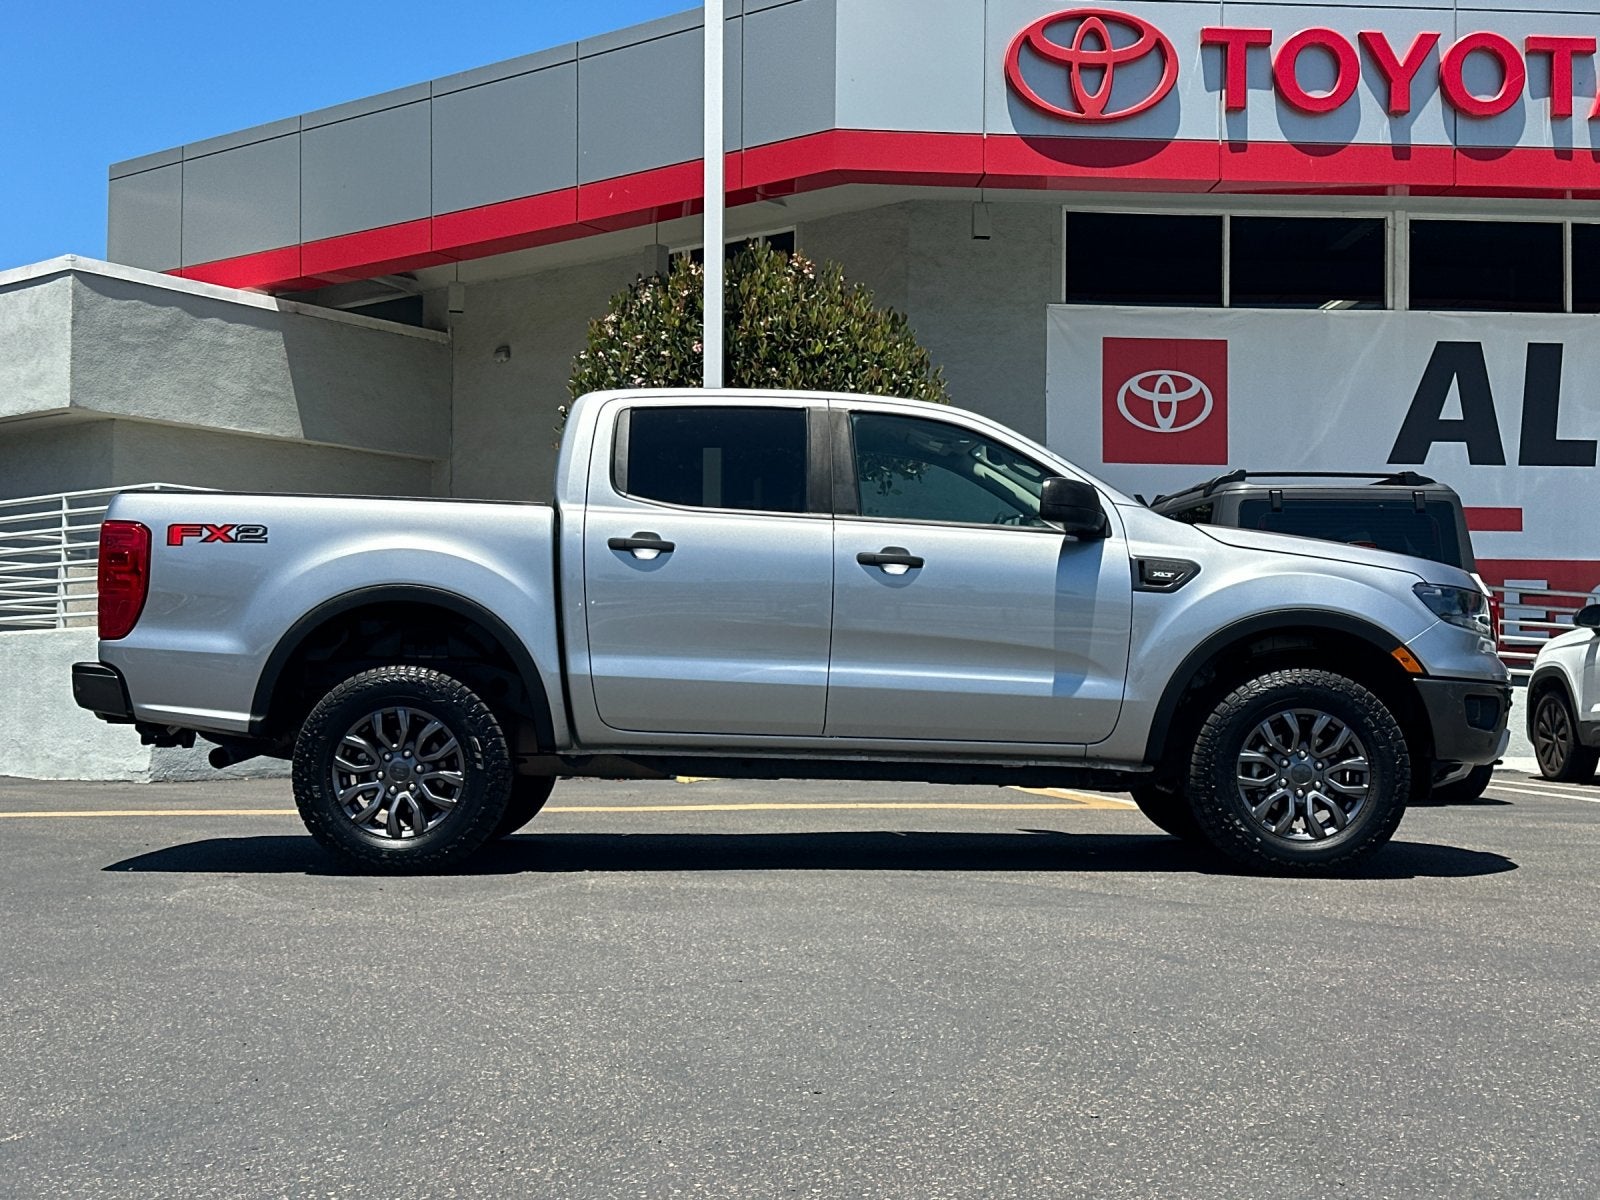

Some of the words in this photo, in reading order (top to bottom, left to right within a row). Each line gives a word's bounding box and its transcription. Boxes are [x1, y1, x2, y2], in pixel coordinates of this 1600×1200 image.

[1201, 27, 1600, 119] TOYOT
[1386, 340, 1598, 467] AL
[166, 523, 268, 546] FX2
